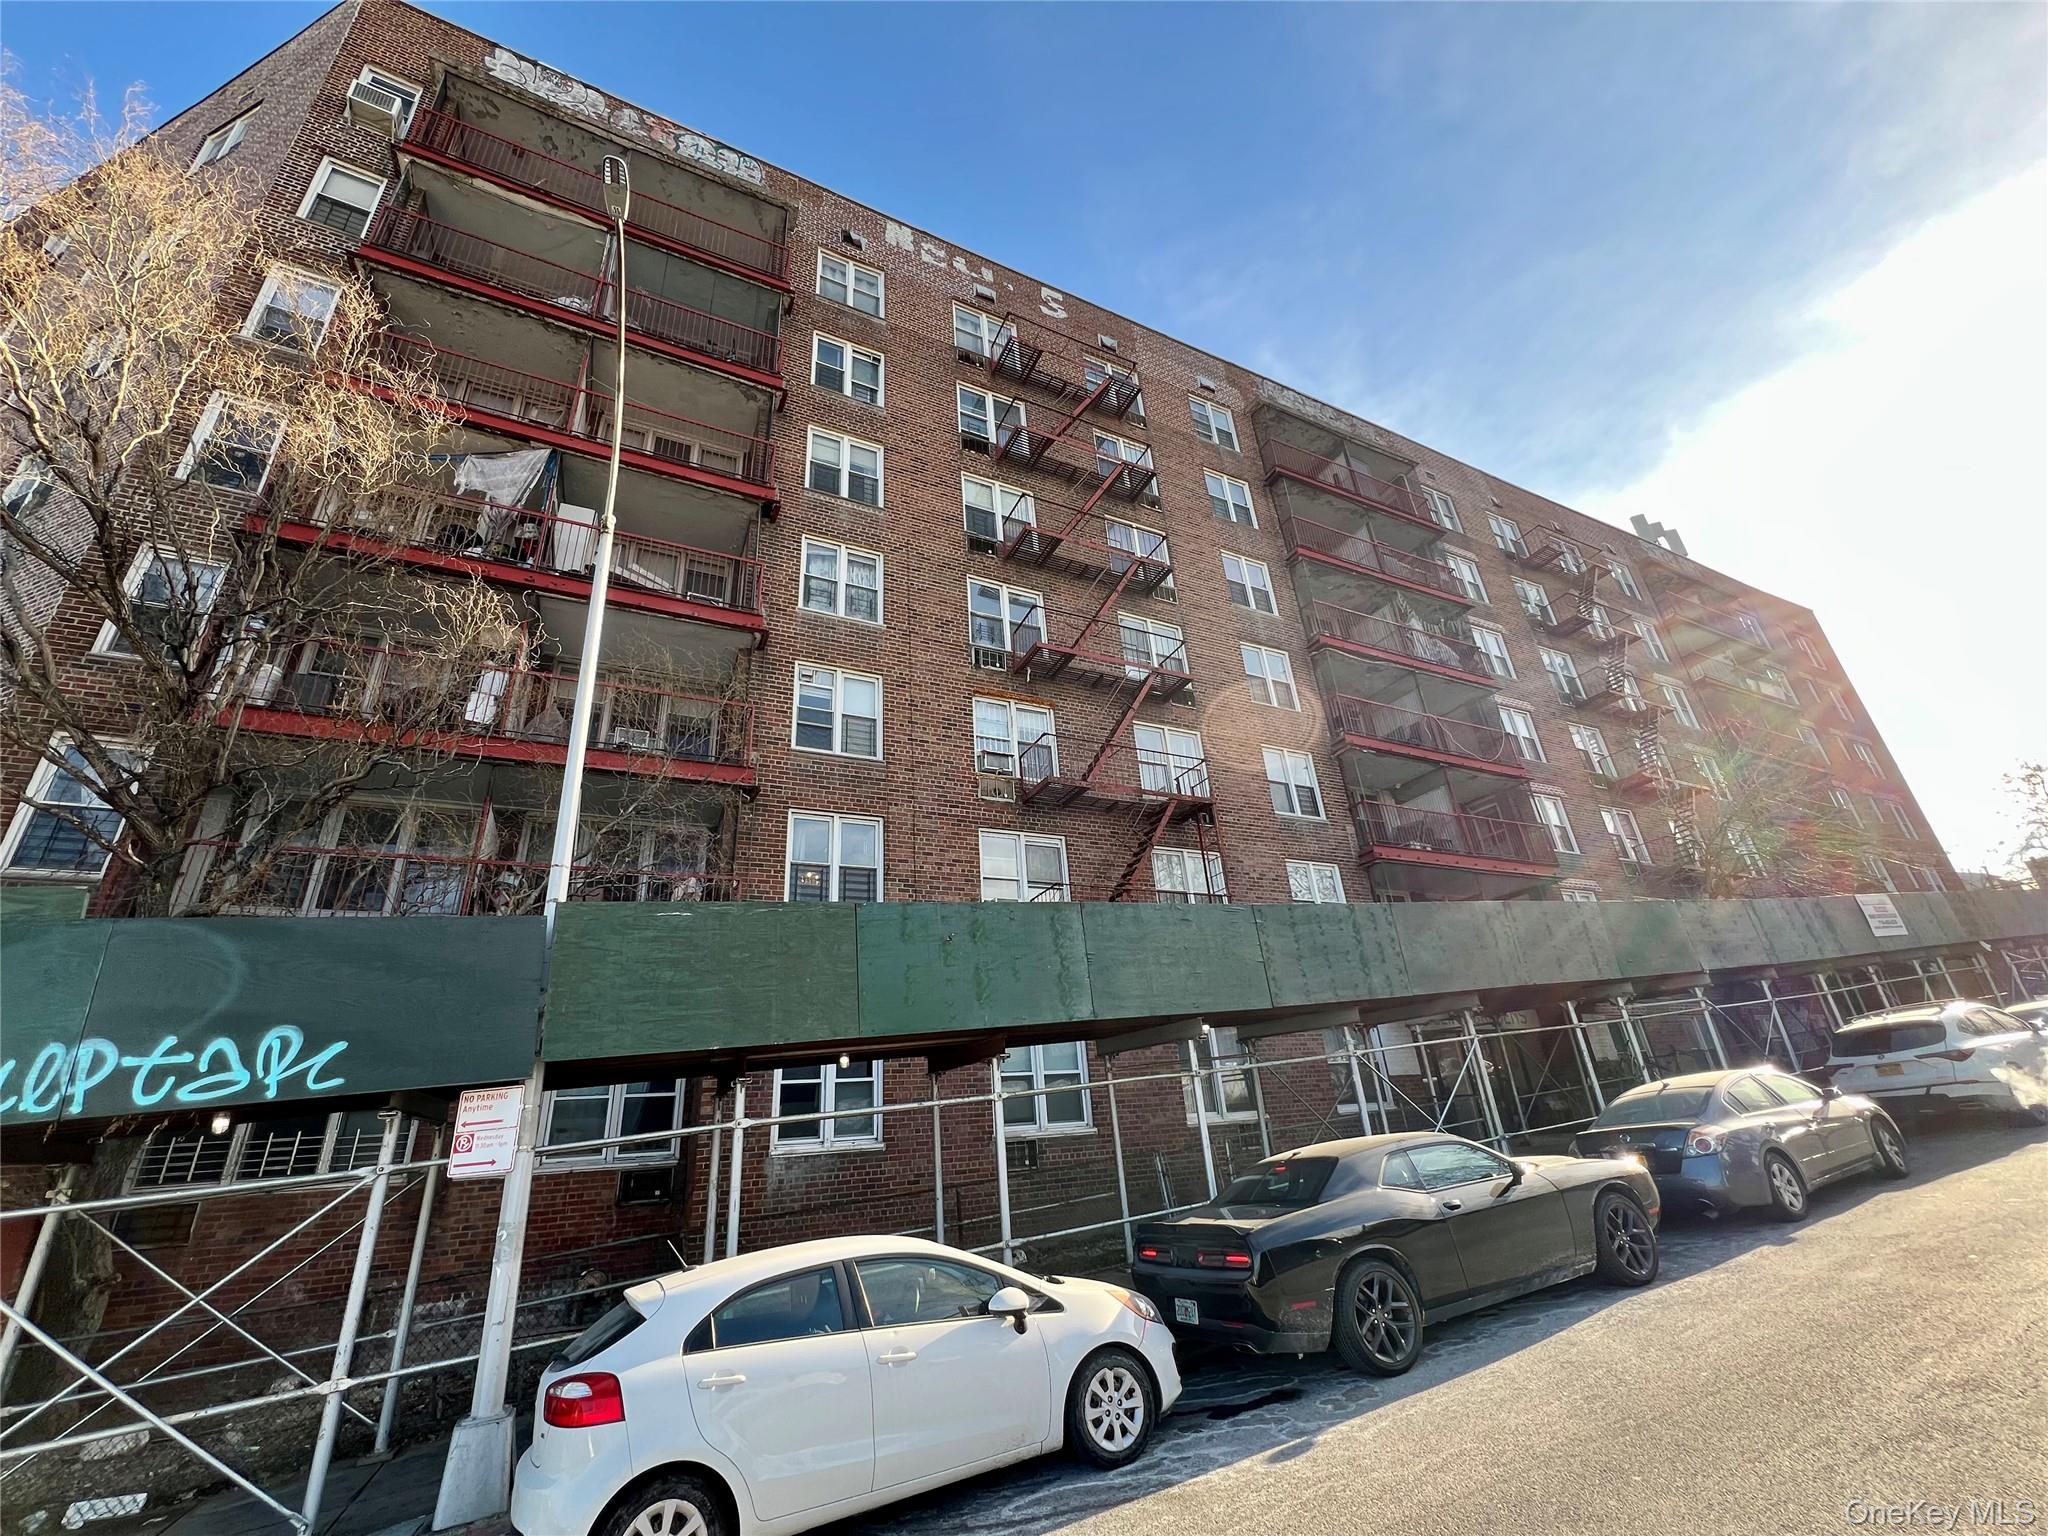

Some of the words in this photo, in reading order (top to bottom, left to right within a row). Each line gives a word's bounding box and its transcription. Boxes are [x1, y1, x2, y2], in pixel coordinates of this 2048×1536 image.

[463, 1095, 475, 1104] NO
[477, 1092, 508, 1101] PARKING
[462, 1104, 493, 1113] Anytime
